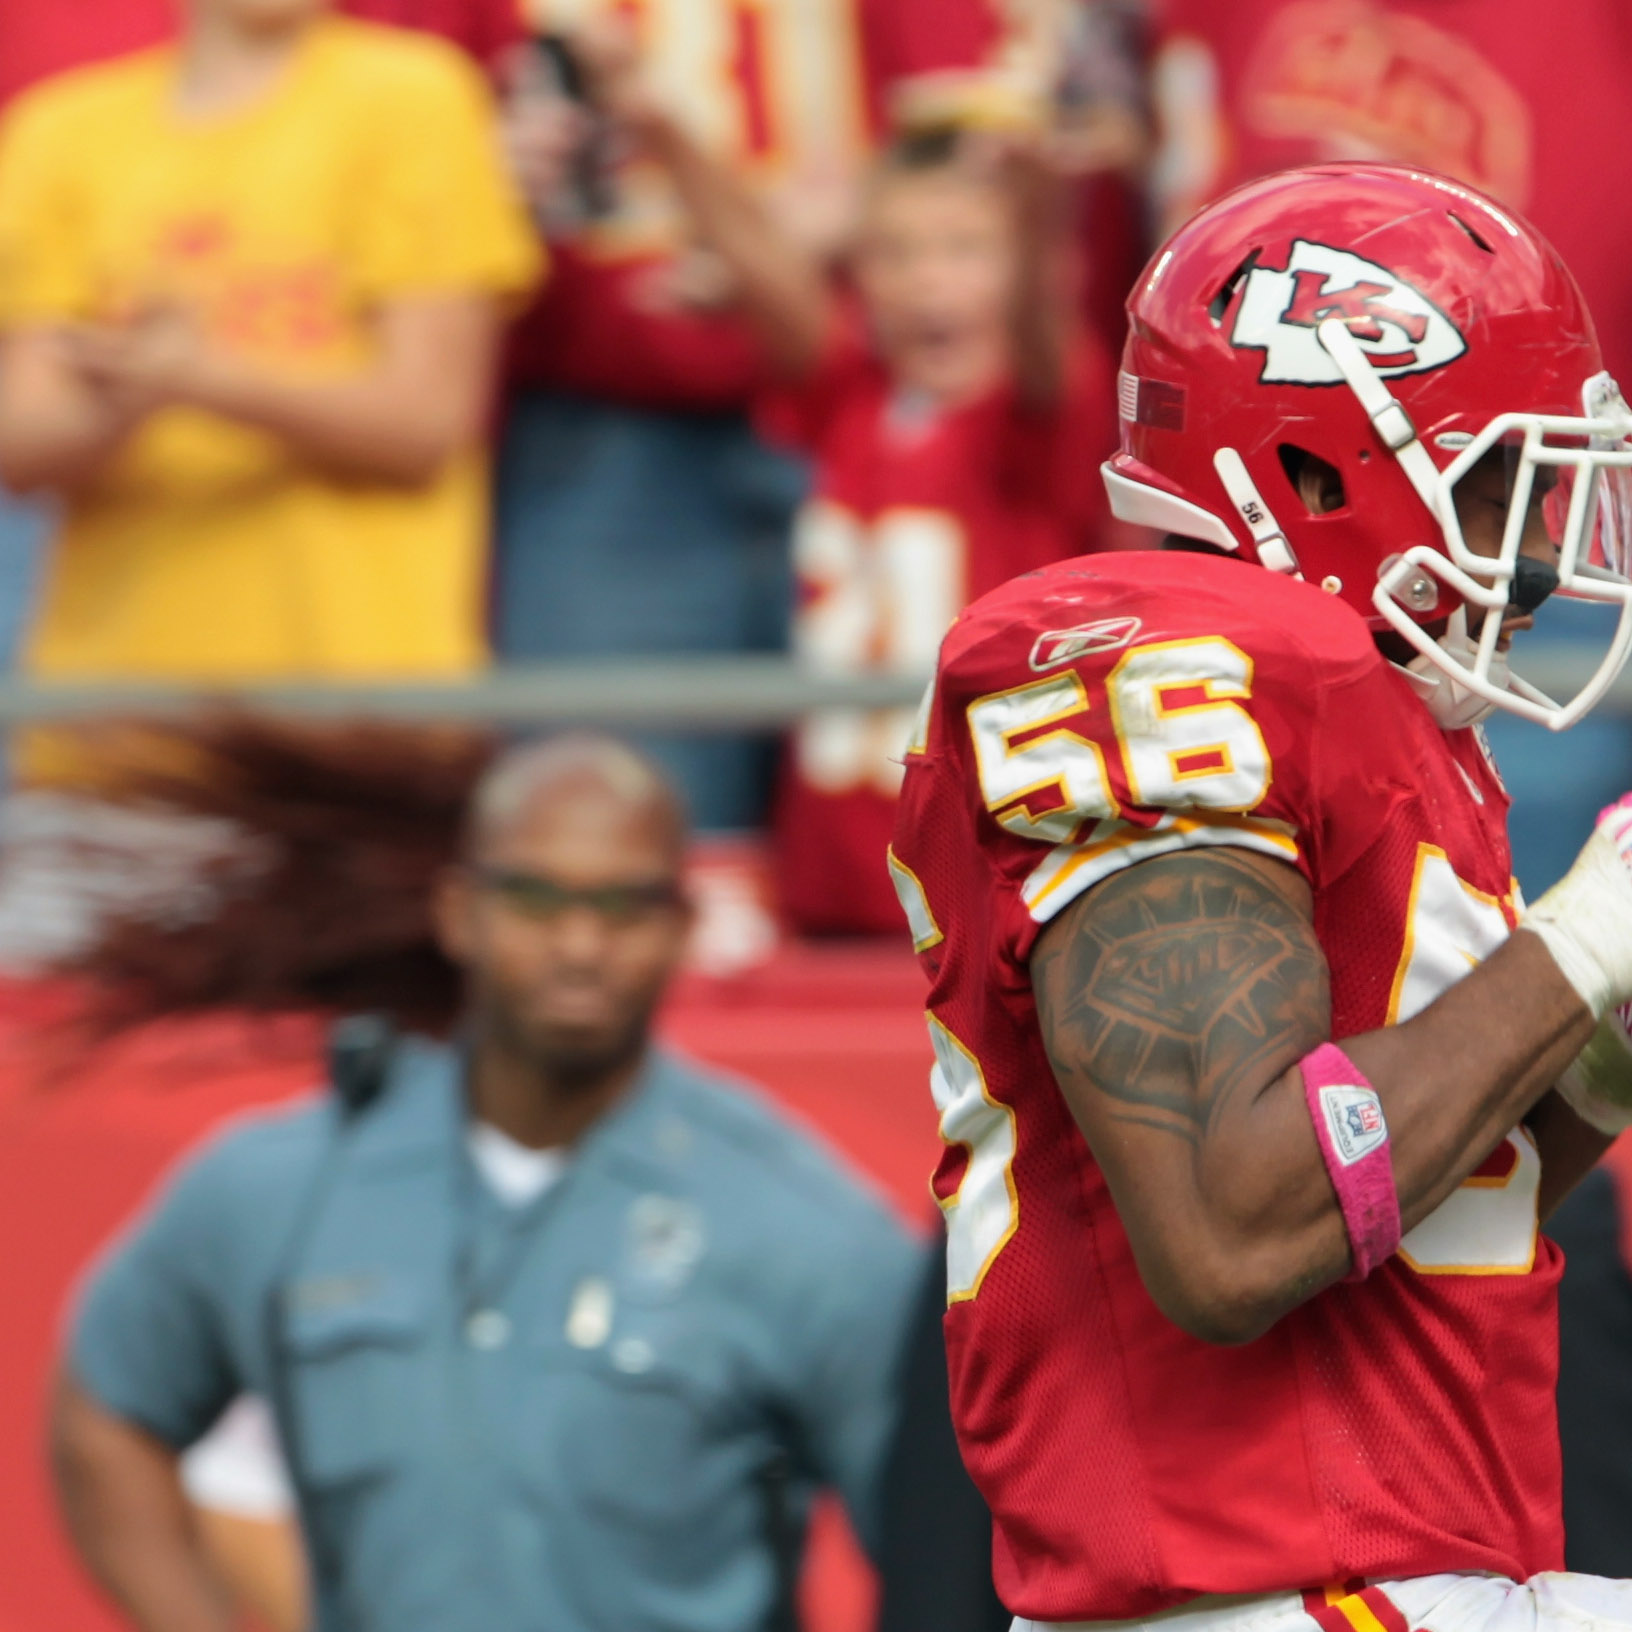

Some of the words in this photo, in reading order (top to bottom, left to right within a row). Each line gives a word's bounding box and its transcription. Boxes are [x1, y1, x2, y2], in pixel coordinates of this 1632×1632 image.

[1241, 502, 1265, 524] 56
[966, 635, 1272, 842] 56
[1361, 1103, 1381, 1131] NFL
